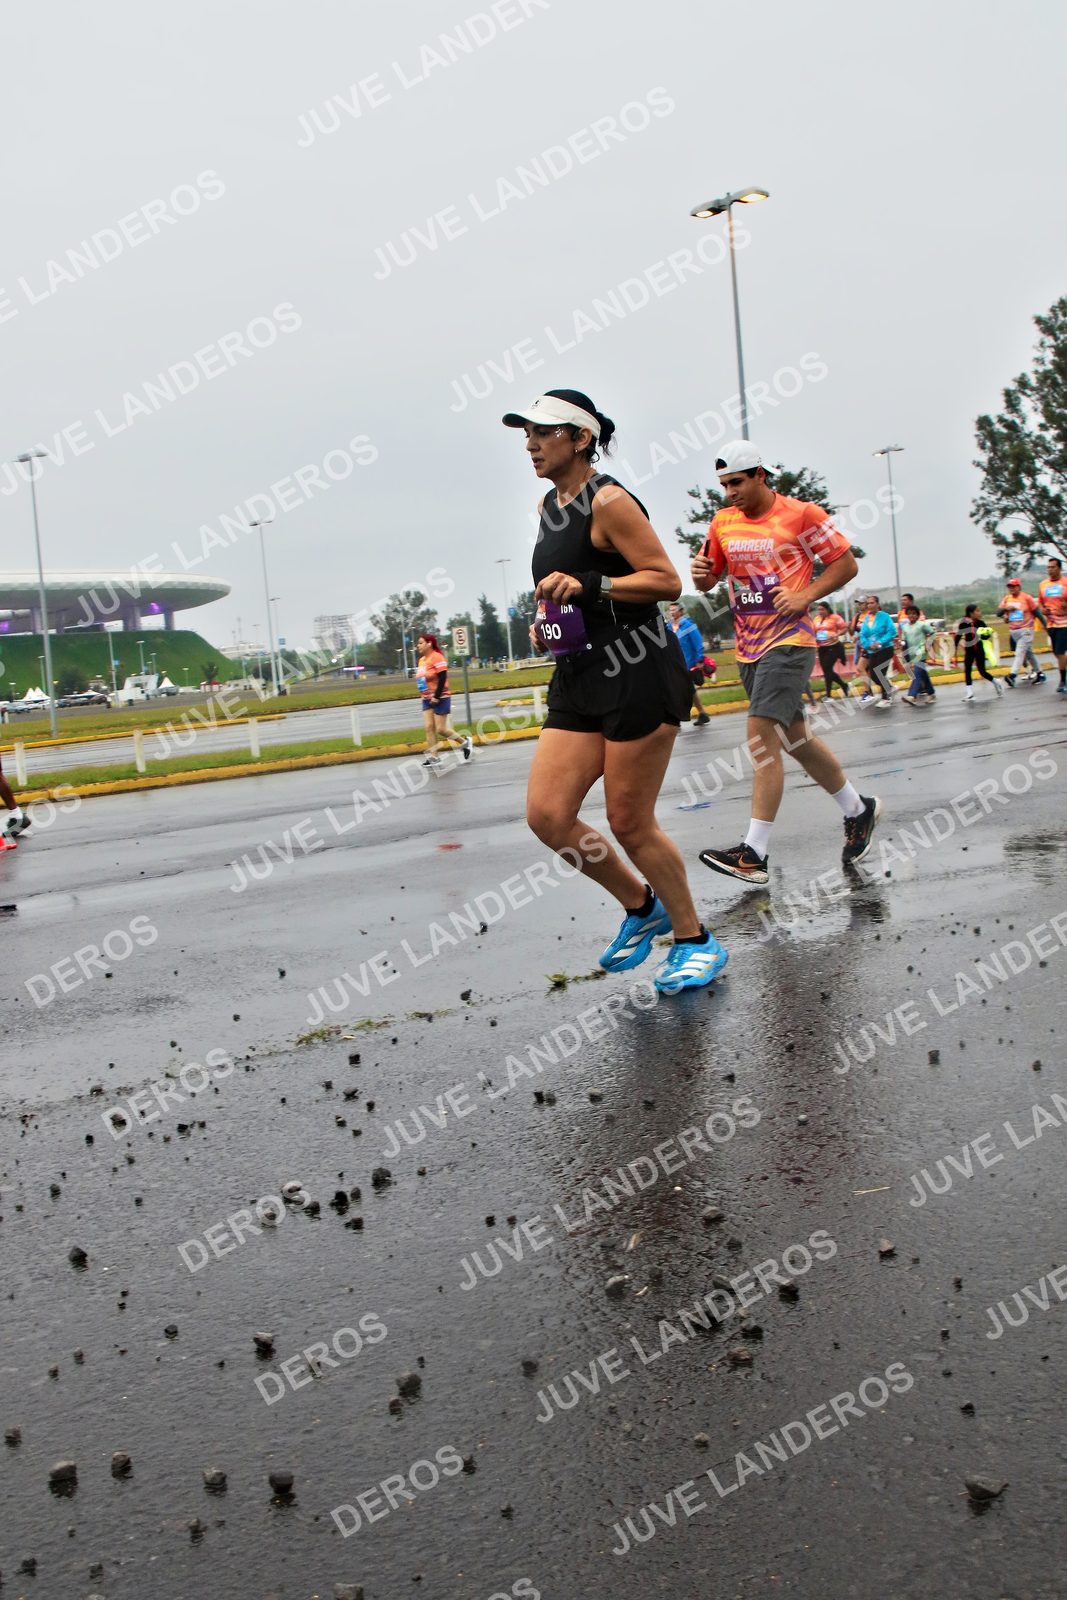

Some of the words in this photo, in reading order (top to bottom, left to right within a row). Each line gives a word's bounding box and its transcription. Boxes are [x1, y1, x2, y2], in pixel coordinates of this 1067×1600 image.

[727, 538, 775, 552] CARRERA
[741, 592, 764, 605] 646
[540, 623, 562, 640] 190
